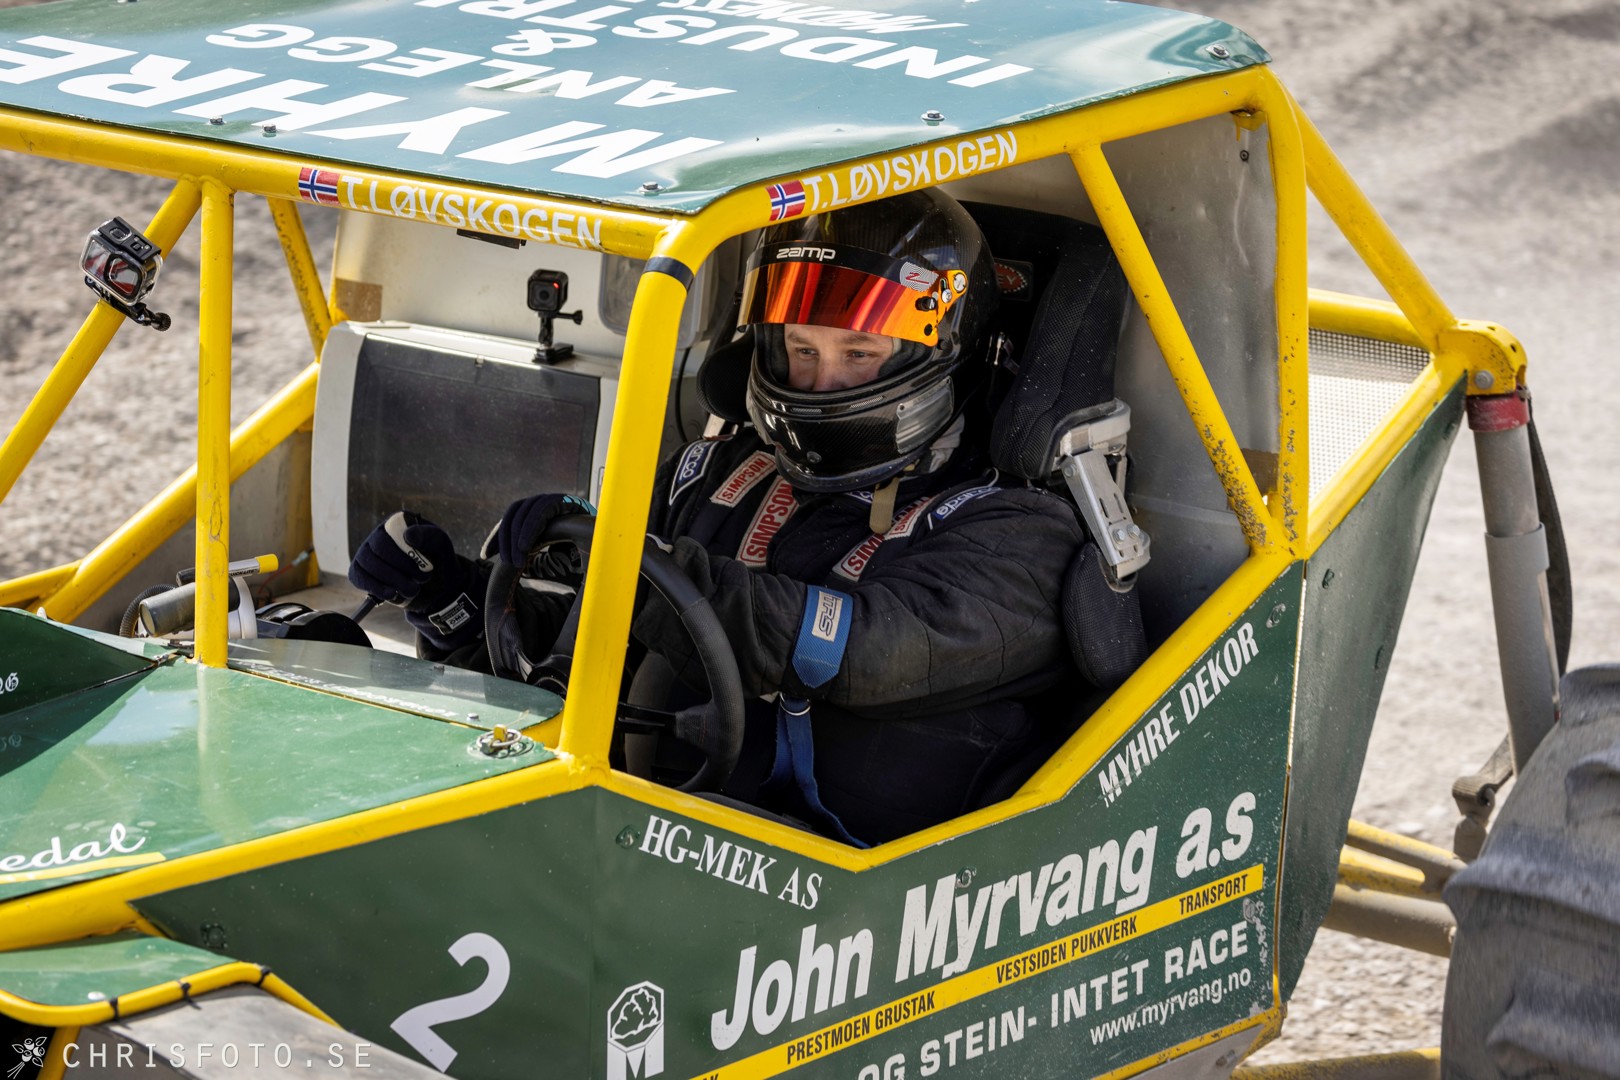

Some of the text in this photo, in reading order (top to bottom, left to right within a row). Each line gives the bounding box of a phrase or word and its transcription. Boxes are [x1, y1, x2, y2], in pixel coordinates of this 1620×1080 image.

[205, 24, 737, 108] ANLEGG
[492, 28, 598, 56] &
[0, 35, 724, 179] MYHRE
[341, 175, 602, 249] T.LØVSKOGEN
[801, 131, 1017, 211] T.LØVSKOGEN
[776, 246, 836, 261] zamp
[722, 454, 768, 500] SIMPSON
[746, 479, 794, 560] SIMPSON
[1098, 622, 1259, 808] MYHRE DEKOR
[639, 815, 823, 910] HG-MEK AS
[710, 791, 1257, 1051] John Myrvang a.s
[389, 932, 511, 1072] 2
[787, 873, 1249, 1065] PRESTMOEN GRUSTAK VESTSIDEN PUKKVERK TRANSPORT
[920, 1006, 1037, 1078] STEIN-
[1051, 959, 1150, 1028] INTET
[1164, 920, 1249, 984] RACE
[1090, 969, 1252, 1046] www.myrvang.no
